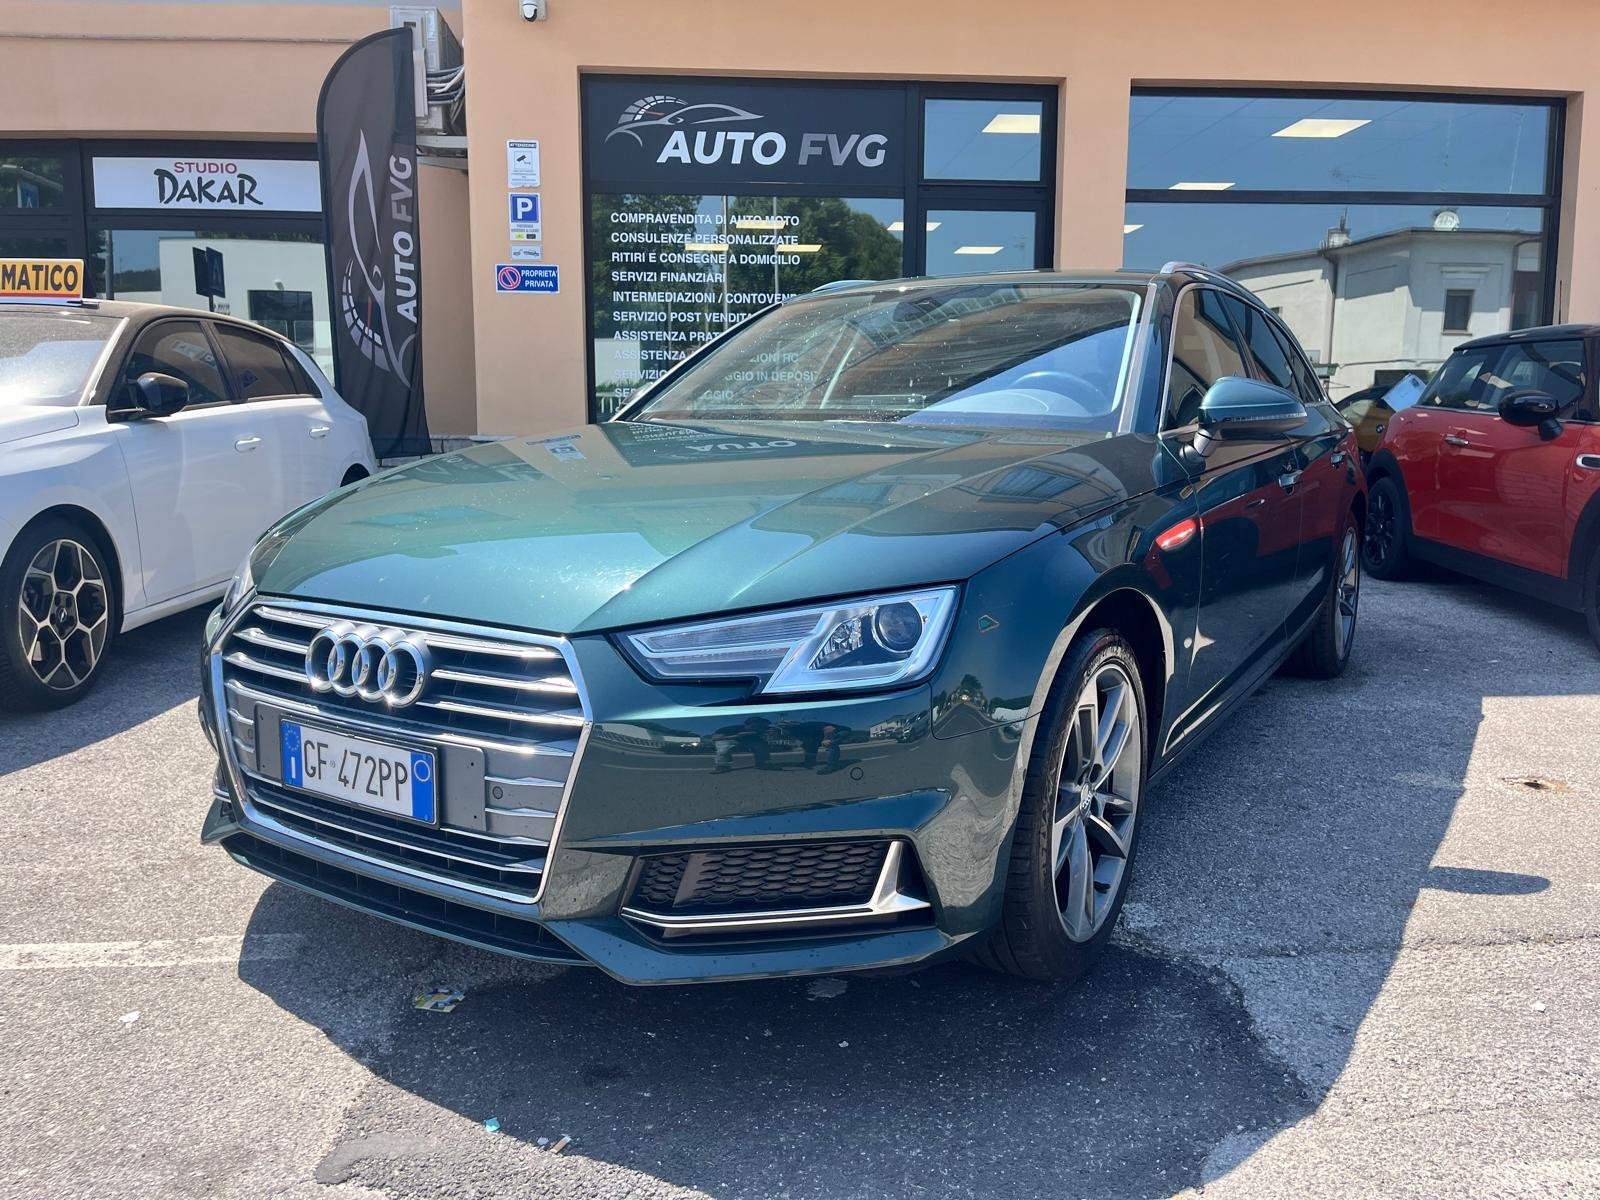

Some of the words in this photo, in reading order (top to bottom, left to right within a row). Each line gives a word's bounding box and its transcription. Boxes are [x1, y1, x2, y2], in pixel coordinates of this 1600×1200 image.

[656, 130, 787, 165] AUTO
[798, 133, 888, 167] FVG
[174, 162, 237, 174] STUDIO
[154, 168, 263, 205] DAKAR
[389, 155, 413, 223] FVG
[611, 213, 710, 224] COMPRAVENDITA
[716, 214, 726, 225] DI
[730, 214, 761, 225] AUTO
[765, 215, 800, 226] MOTO
[611, 232, 691, 244] CONSULENZE
[695, 234, 798, 245] PERSONALIZZATE
[612, 252, 645, 263] RITIRI
[649, 253, 656, 263] E
[660, 253, 726, 264] CONSEGNE
[728, 254, 736, 264] A
[740, 254, 800, 265] DOMICILIO
[2, 264, 78, 291] MATICO
[393, 231, 417, 323] AUTO
[612, 272, 657, 282] SERVIZI
[660, 272, 726, 283] FINANZIARI
[525, 280, 554, 288] PRIVATA
[613, 291, 715, 303] INTERMEDIAZIONI
[613, 311, 667, 321] SERVIZIO
[670, 312, 700, 322] POST
[613, 331, 686, 341] ASSISTENZA
[614, 350, 686, 360] ASSISTENZA
[756, 371, 768, 381] IN
[304, 740, 328, 780] GF
[338, 750, 408, 800] 472PP
